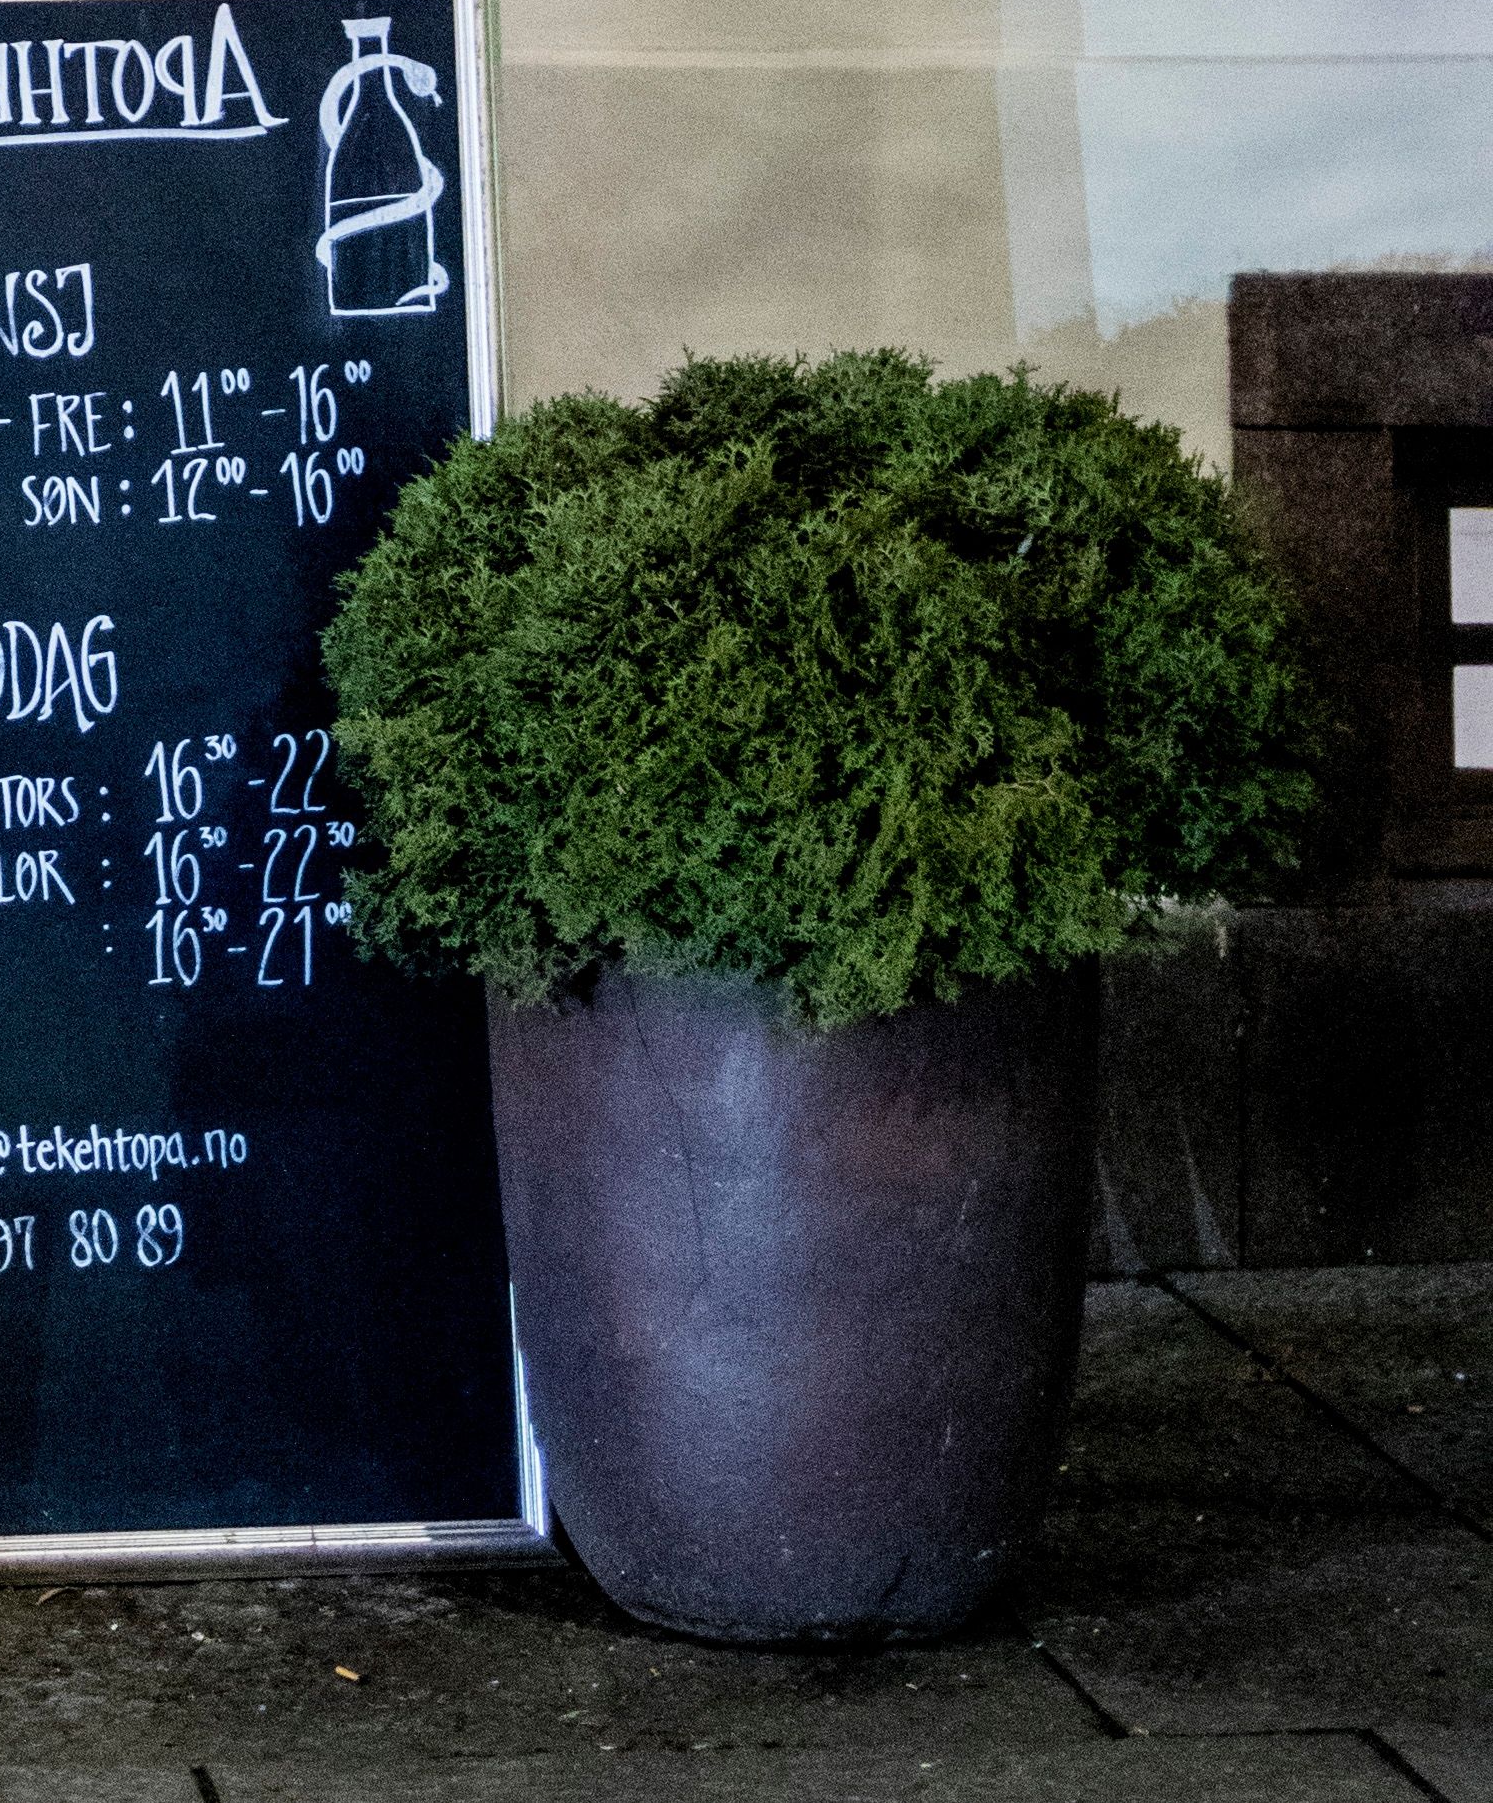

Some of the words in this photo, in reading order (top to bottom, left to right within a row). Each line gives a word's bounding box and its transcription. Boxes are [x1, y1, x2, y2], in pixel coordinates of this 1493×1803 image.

[20, 474, 101, 528] SØN
[68, 1208, 119, 1269] 80
[135, 1203, 183, 1268] 89
